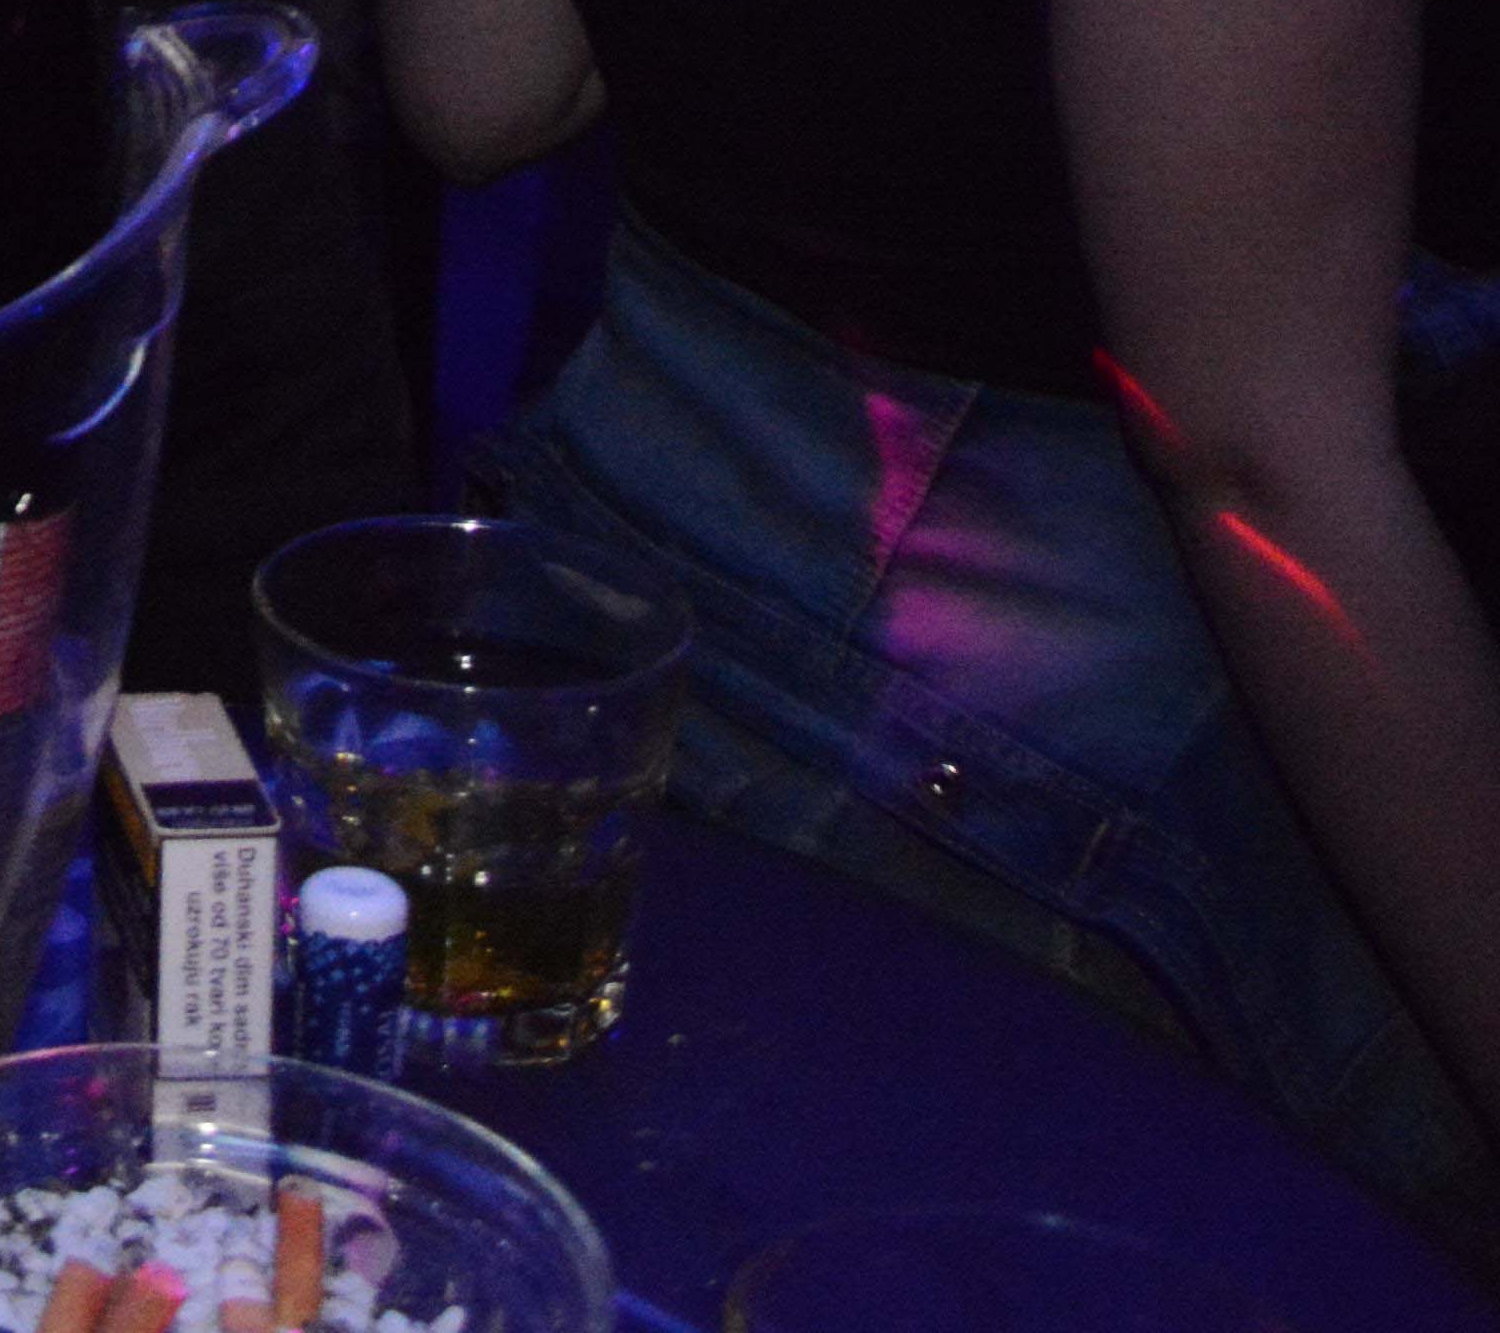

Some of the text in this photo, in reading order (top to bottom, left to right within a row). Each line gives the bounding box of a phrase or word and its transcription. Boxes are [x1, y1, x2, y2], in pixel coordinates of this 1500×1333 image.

[210, 901, 228, 929] od
[236, 846, 256, 949] Duhanski
[182, 891, 204, 1026] uzrokuju rak
[210, 935, 230, 960] 70
[234, 957, 253, 996] dim
